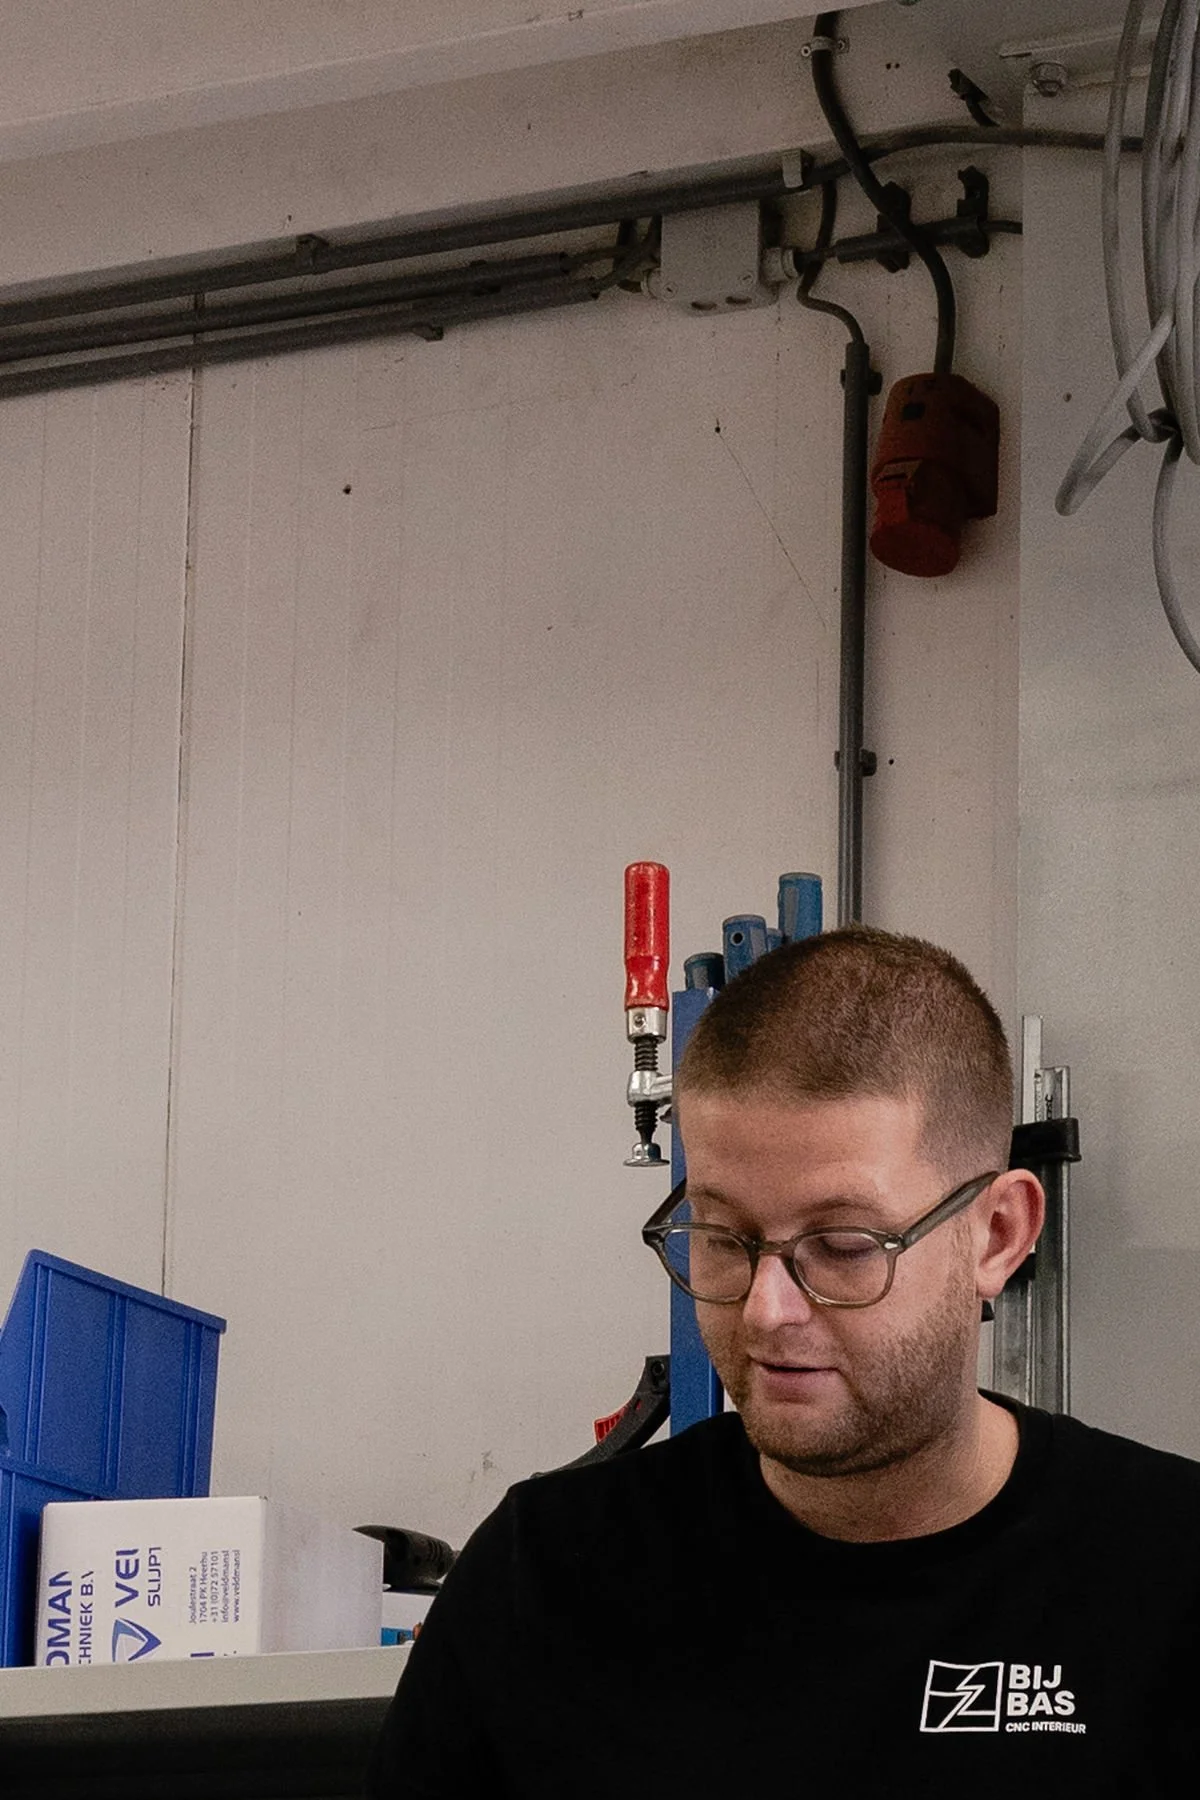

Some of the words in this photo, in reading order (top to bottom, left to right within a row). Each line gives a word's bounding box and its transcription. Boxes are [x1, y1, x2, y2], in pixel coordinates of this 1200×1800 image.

[1009, 1664, 1062, 1690] BIJ
[1007, 1690, 1076, 1716] BAS
[1005, 1722, 1031, 1733] CNC
[1031, 1721, 1086, 1734] INTERIEUR
